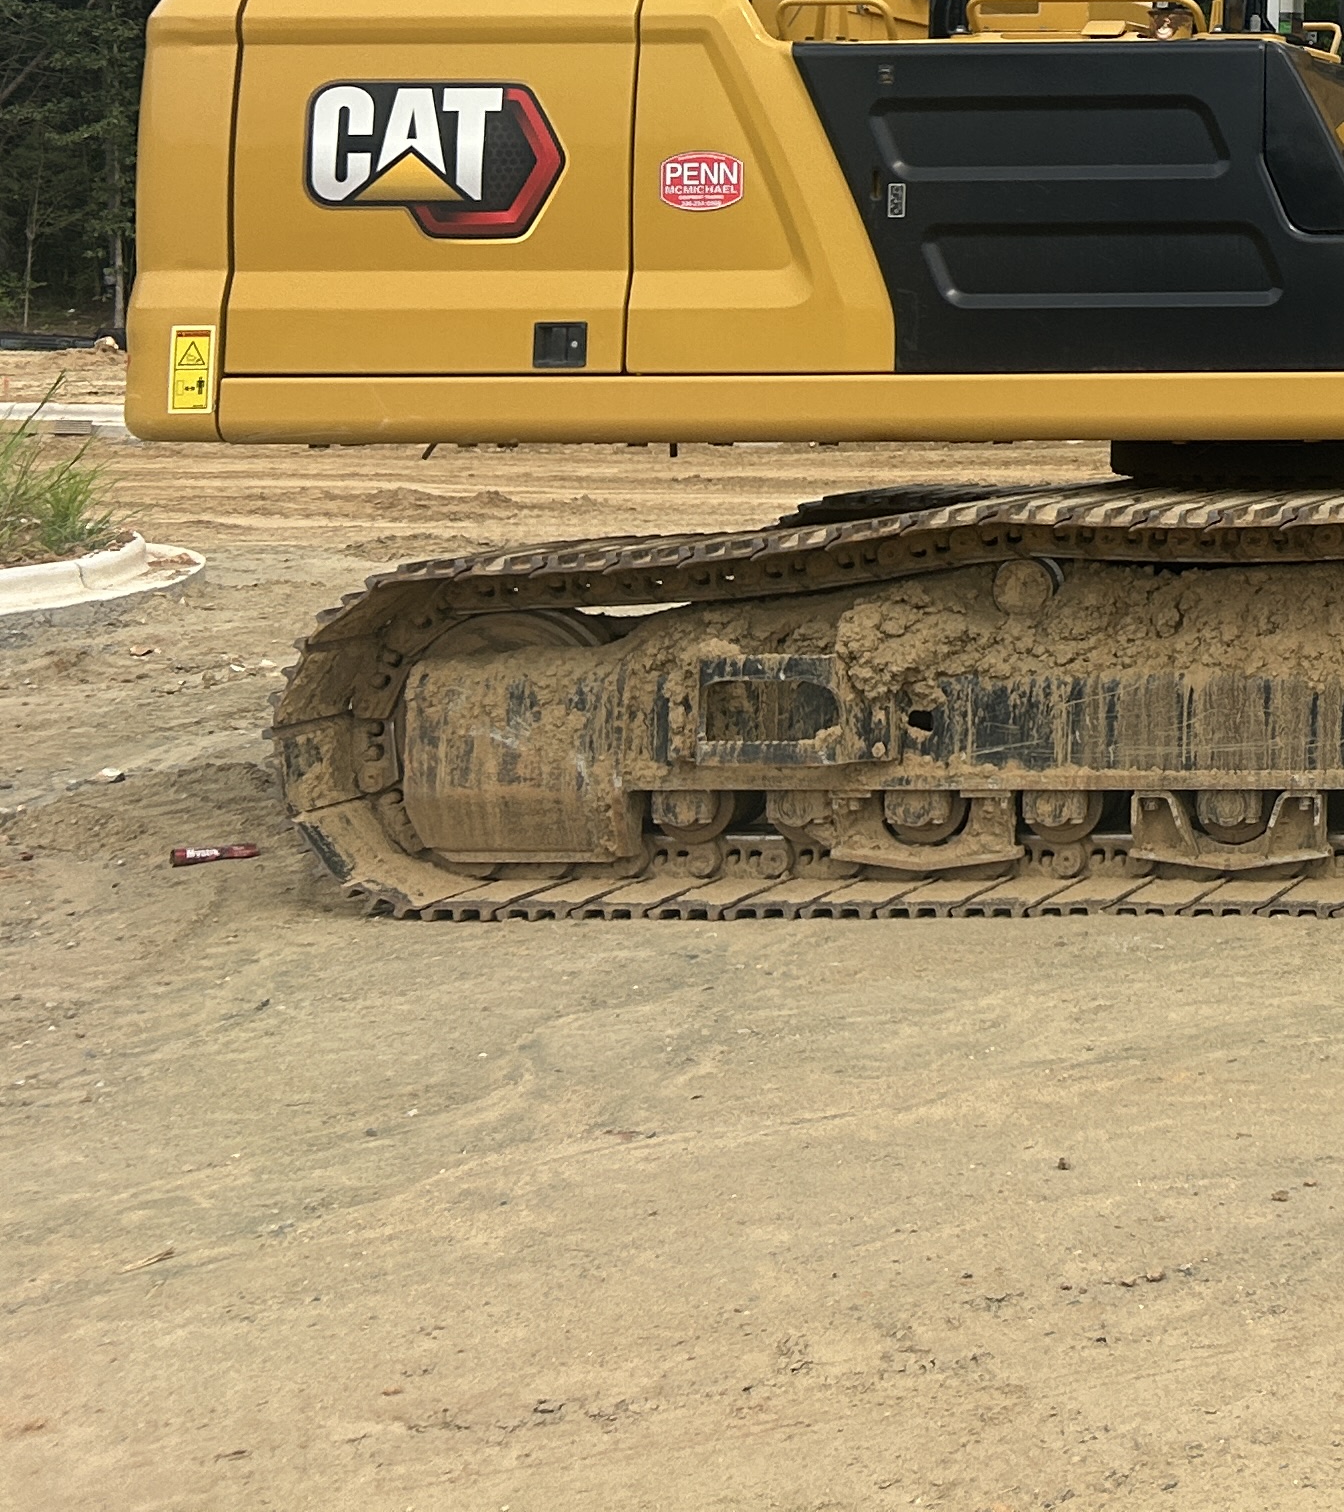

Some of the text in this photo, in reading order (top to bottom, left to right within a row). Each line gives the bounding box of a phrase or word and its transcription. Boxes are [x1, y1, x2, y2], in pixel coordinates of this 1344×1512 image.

[312, 86, 503, 201] CAT
[665, 162, 738, 185] PENN
[664, 185, 739, 195] MCMICHAEL
